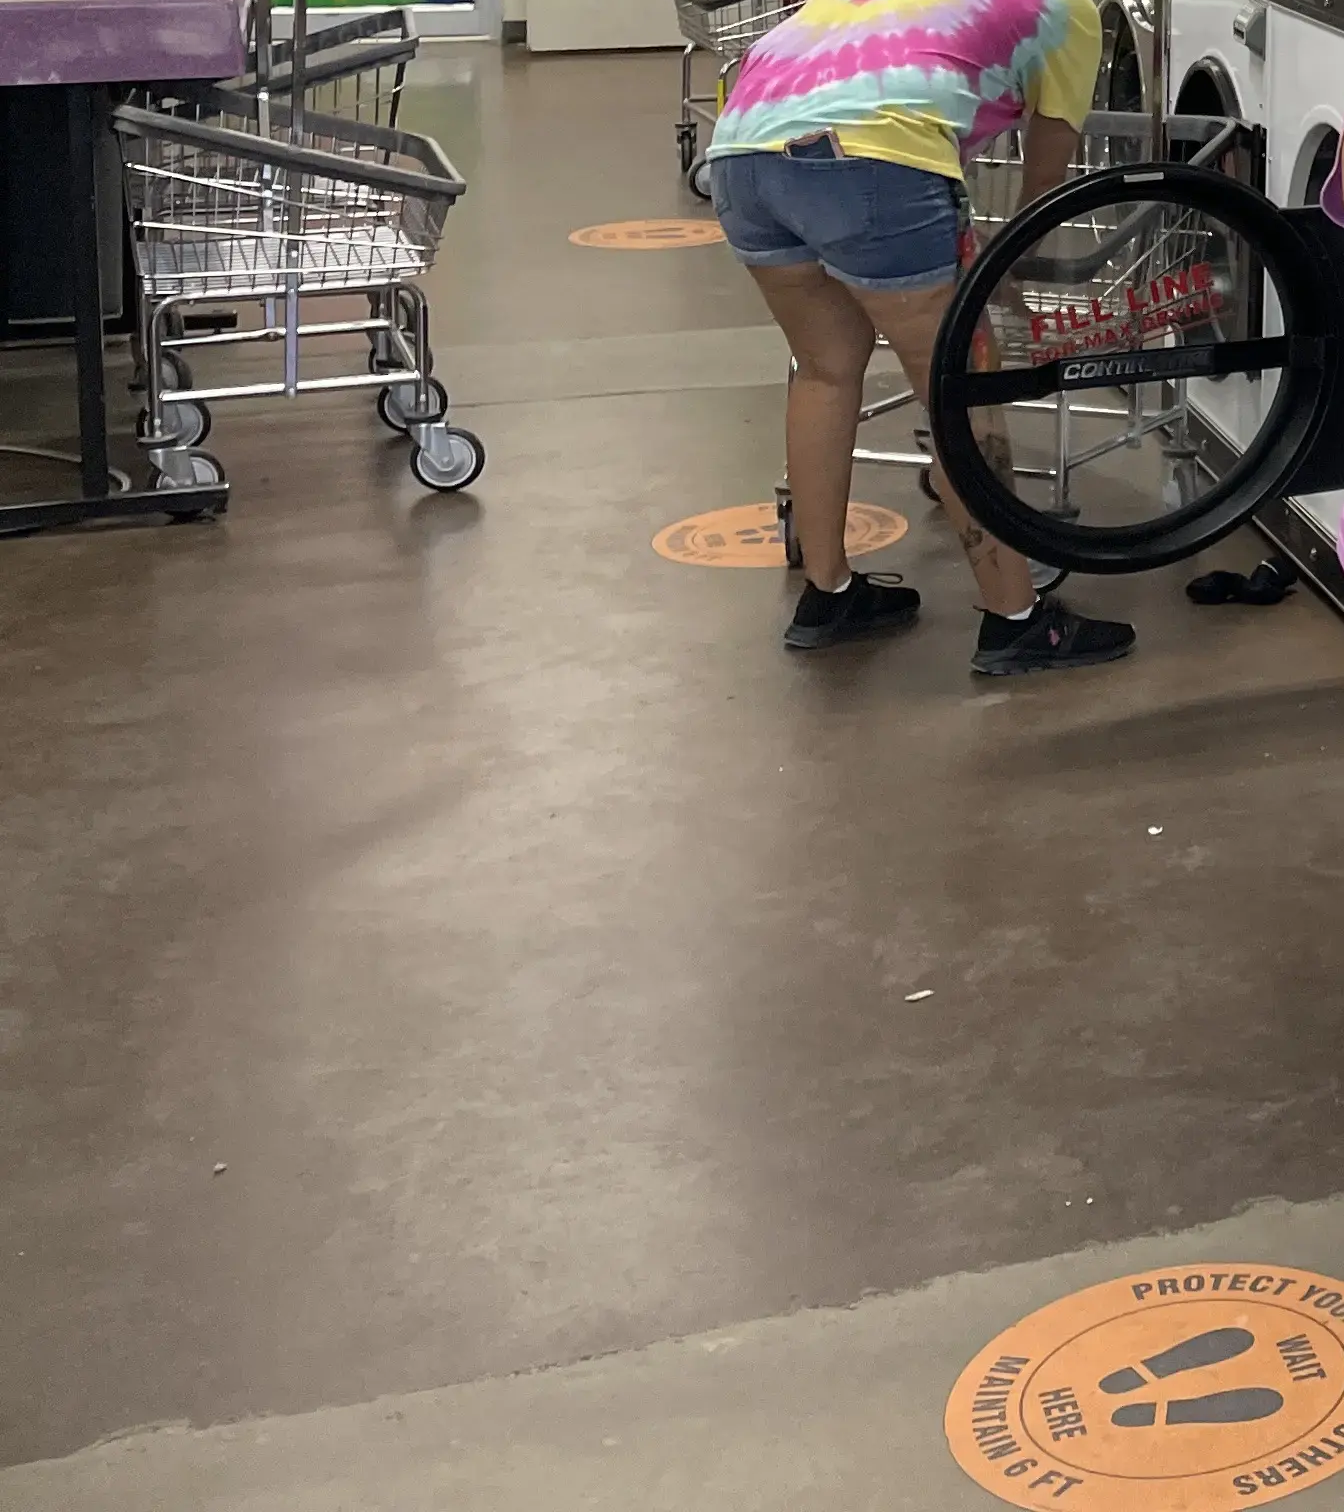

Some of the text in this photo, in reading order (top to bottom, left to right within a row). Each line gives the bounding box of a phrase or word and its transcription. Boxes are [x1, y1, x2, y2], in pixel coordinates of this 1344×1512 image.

[1030, 262, 1214, 344] FILL LINE
[1130, 1272, 1298, 1302] PROTECT
[1276, 1332, 1328, 1384] WAIT
[970, 1354, 1085, 1499] MAINTAIN 6 FT
[1037, 1386, 1088, 1443] HERE
